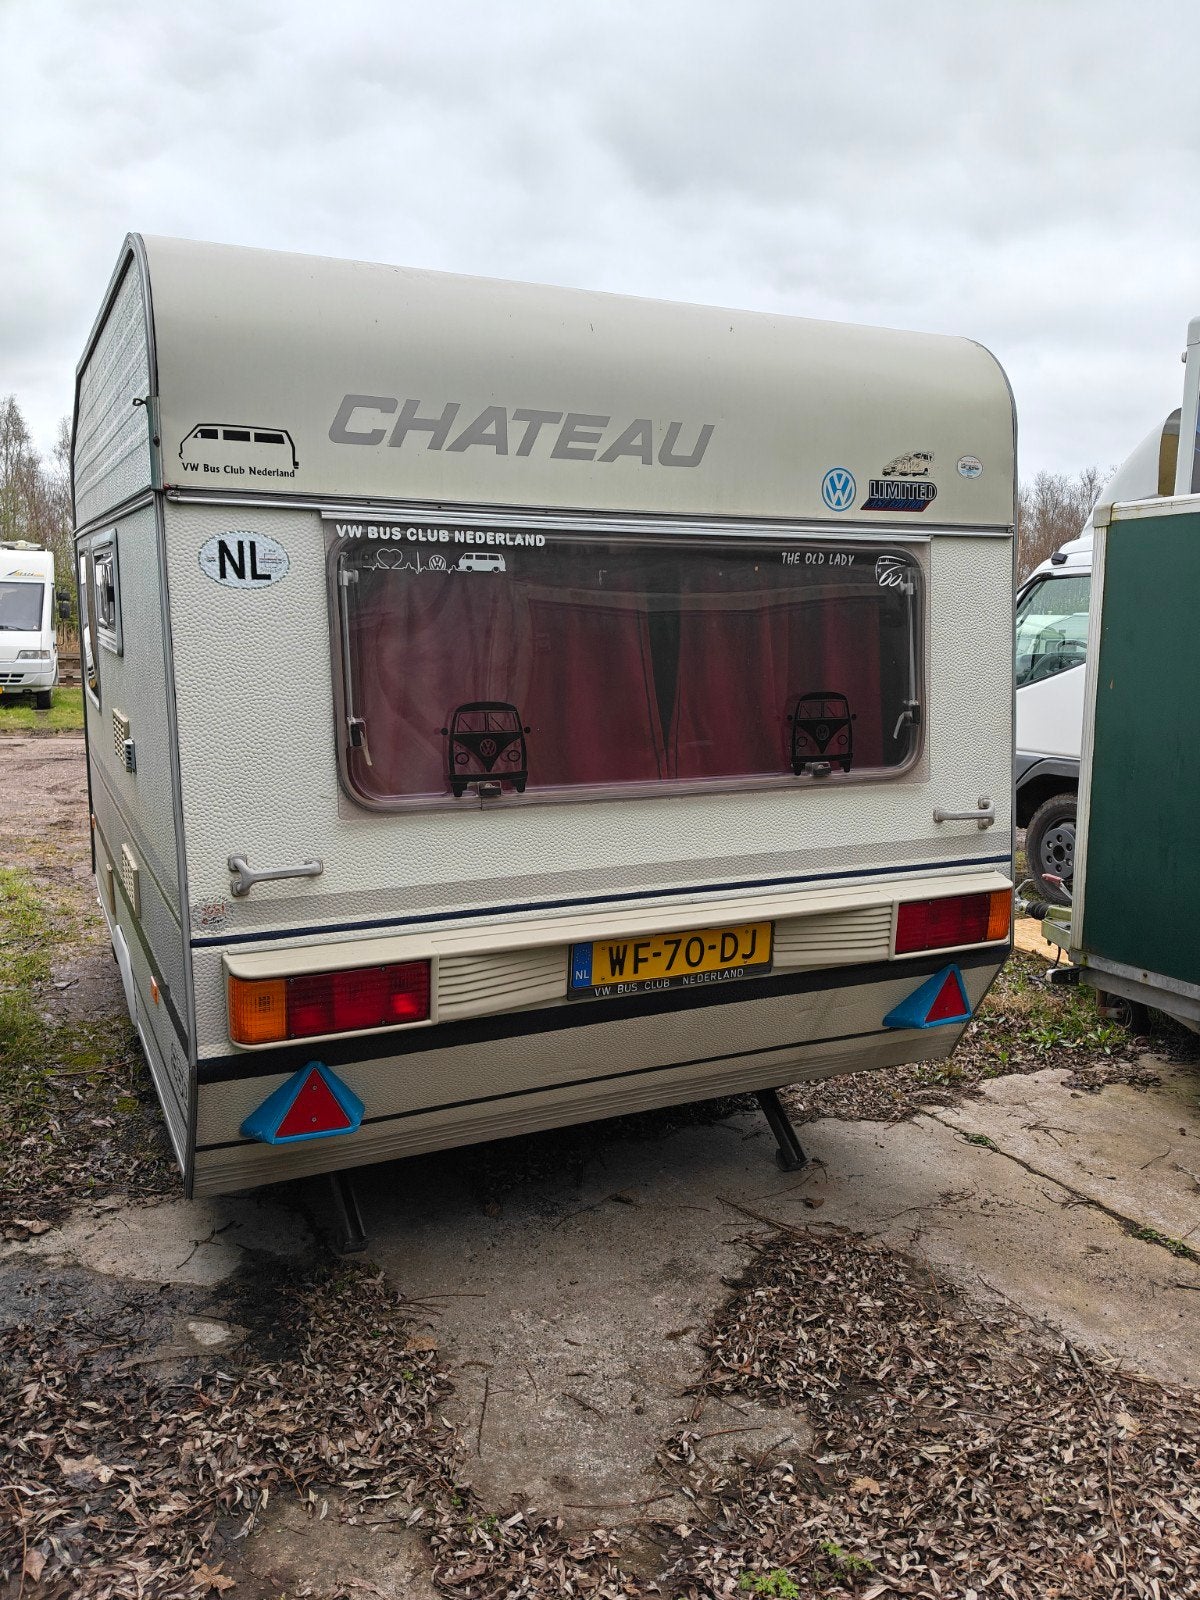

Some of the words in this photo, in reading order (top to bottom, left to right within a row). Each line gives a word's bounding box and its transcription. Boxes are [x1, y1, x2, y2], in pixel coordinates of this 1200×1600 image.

[329, 394, 715, 467] CHATEAU
[182, 462, 199, 471] VW
[203, 463, 220, 473] Bus
[223, 465, 245, 474] Club
[249, 466, 295, 478] Nederland
[869, 480, 936, 500] LIMITED
[336, 524, 362, 538] VW
[367, 526, 401, 540] BUS
[406, 528, 450, 542] CLUB
[454, 530, 546, 547] NEDERLAND
[218, 539, 272, 580] NL
[781, 552, 800, 565] THE
[805, 552, 825, 565] OLD
[829, 553, 855, 566] LADY
[608, 930, 757, 976] WF-70-DJ
[575, 970, 590, 980] NL
[595, 986, 611, 997] VW
[617, 983, 638, 994] BUS
[644, 979, 670, 990] CLUB
[682, 968, 744, 985] NEDERLAND
